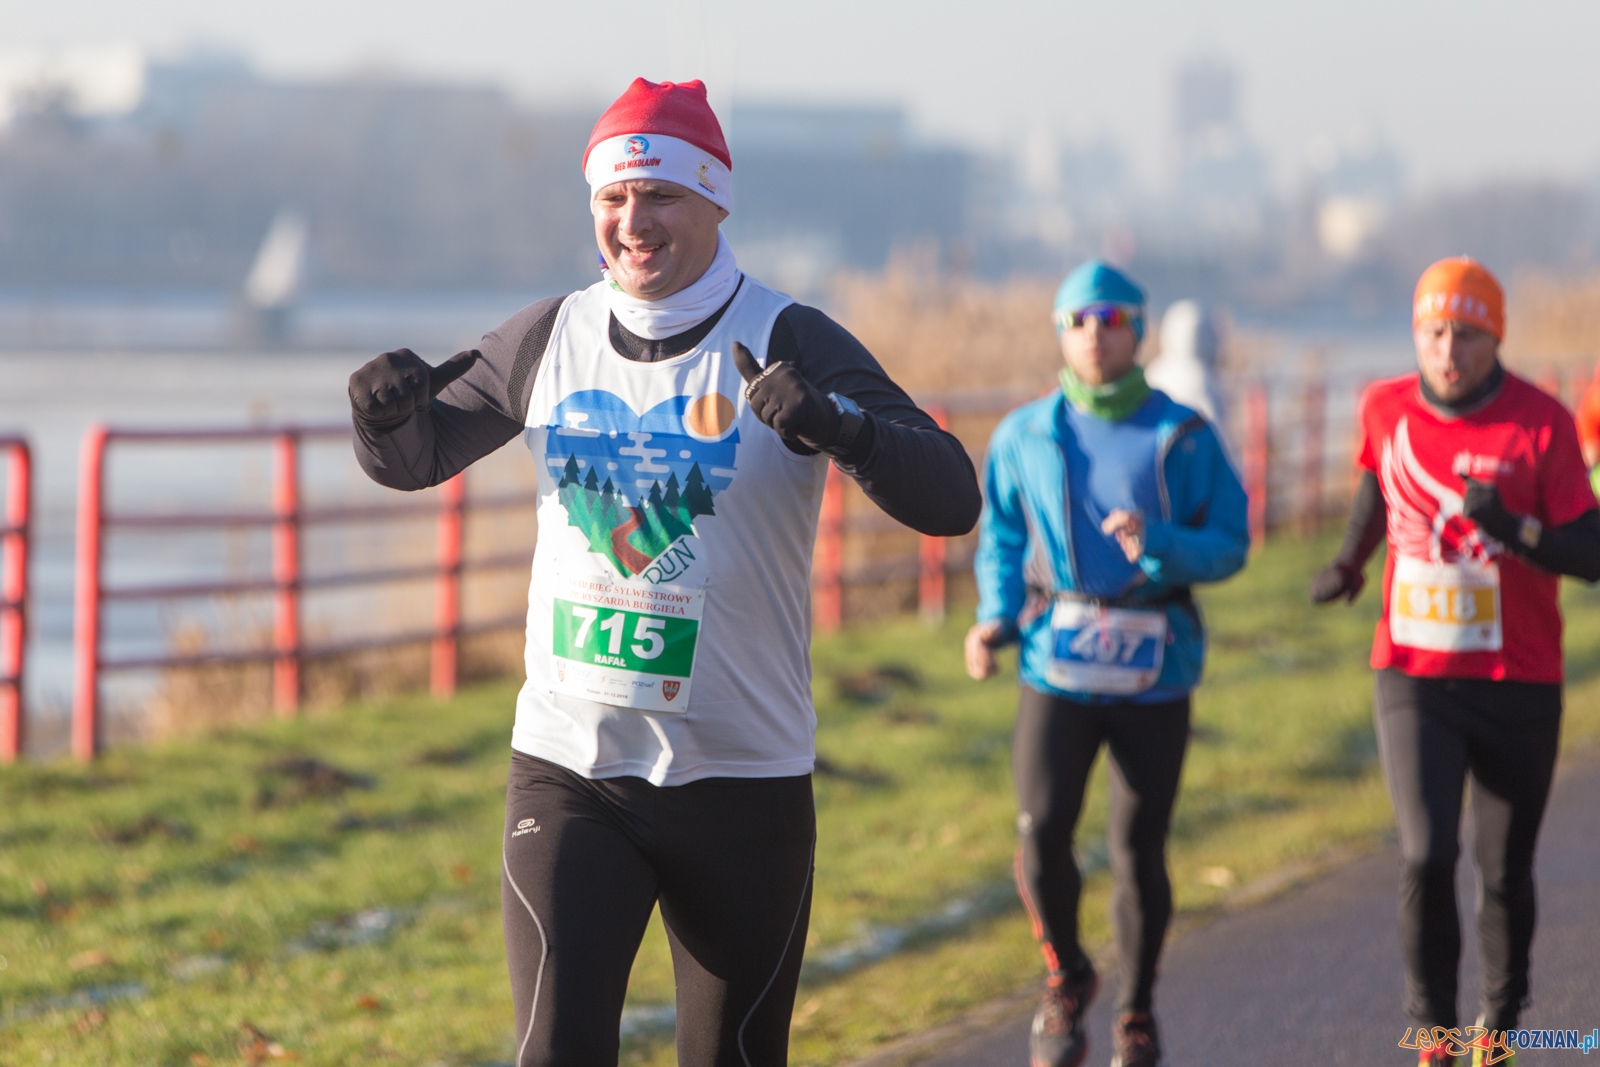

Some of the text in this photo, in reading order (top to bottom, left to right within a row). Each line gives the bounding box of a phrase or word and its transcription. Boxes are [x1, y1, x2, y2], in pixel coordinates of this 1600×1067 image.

[614, 157, 662, 172] BIEG MIKOŁAJÓW
[642, 537, 696, 585] RUN
[582, 594, 630, 607] RYSZARDA
[633, 598, 685, 615] BURGIELA
[589, 582, 612, 592] BIEG
[614, 586, 692, 604] SYLWESTROWY
[1407, 587, 1478, 620] 918
[572, 605, 666, 660] 715
[1070, 624, 1144, 664] 407
[594, 654, 626, 667] RAFAŁ
